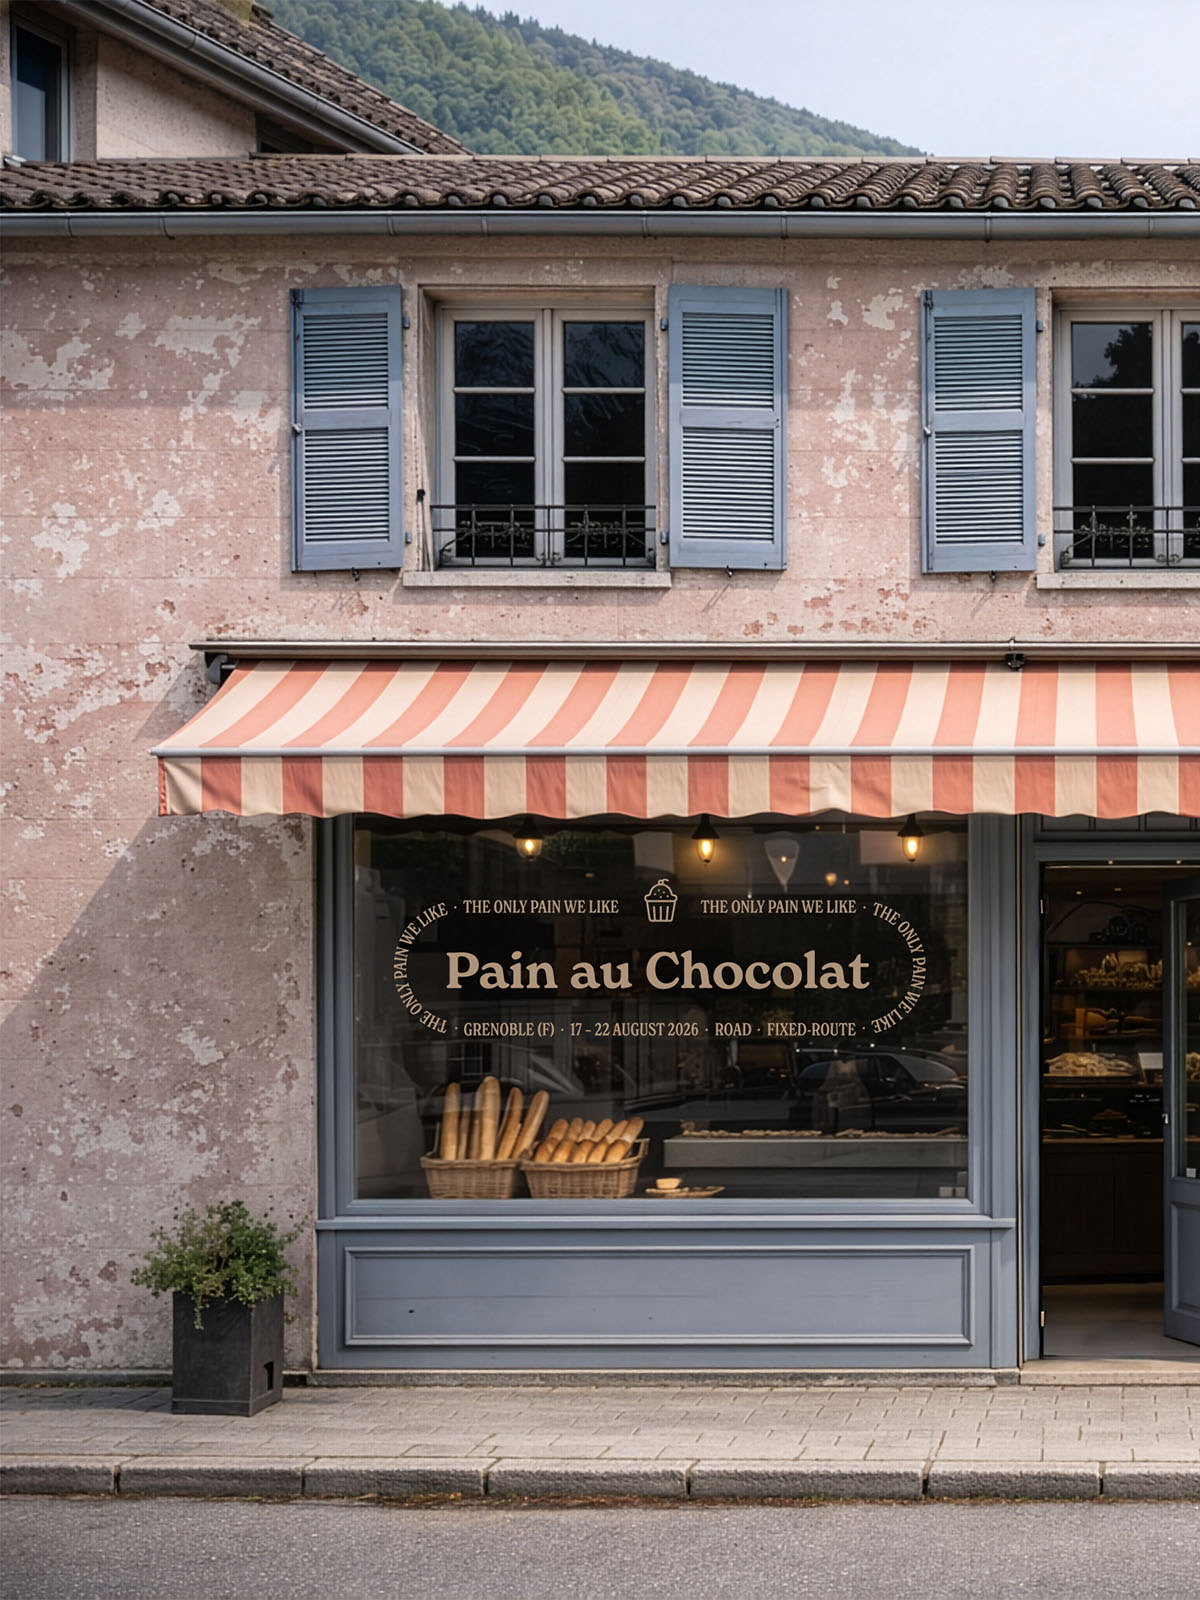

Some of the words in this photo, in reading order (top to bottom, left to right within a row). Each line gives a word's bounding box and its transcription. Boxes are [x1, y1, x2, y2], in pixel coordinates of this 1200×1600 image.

[420, 902, 449, 928] LIKE
[462, 899, 491, 914] THE
[493, 899, 528, 914] ONLY
[530, 899, 561, 914] PAIN
[563, 899, 586, 914] WE
[588, 899, 619, 914] LIKE
[700, 899, 729, 914] THE
[731, 899, 766, 914] ONLY
[767, 899, 799, 914] PAIN
[801, 899, 824, 914] WE
[826, 899, 857, 914] LIKE
[872, 902, 901, 926] THE
[398, 921, 422, 945] WE
[897, 921, 925, 954] ONLY
[393, 946, 410, 980] PAIN
[446, 950, 558, 990] Pain
[570, 961, 633, 990] au
[646, 949, 870, 990] Chocolat
[910, 956, 927, 990] PAIN
[395, 982, 423, 1015] ONLY
[898, 991, 921, 1014] WE
[419, 1010, 447, 1034] THE
[463, 1022, 535, 1037] GRENOBLE
[537, 1022, 555, 1038] (F)
[569, 1022, 582, 1037] 17
[594, 1022, 610, 1037] 22
[612, 1022, 665, 1037] AUGUST
[667, 1022, 699, 1037] 2026
[715, 1022, 752, 1037] ROAD
[767, 1022, 857, 1037] FIXED-ROUTE
[871, 1008, 903, 1034] LIKE
